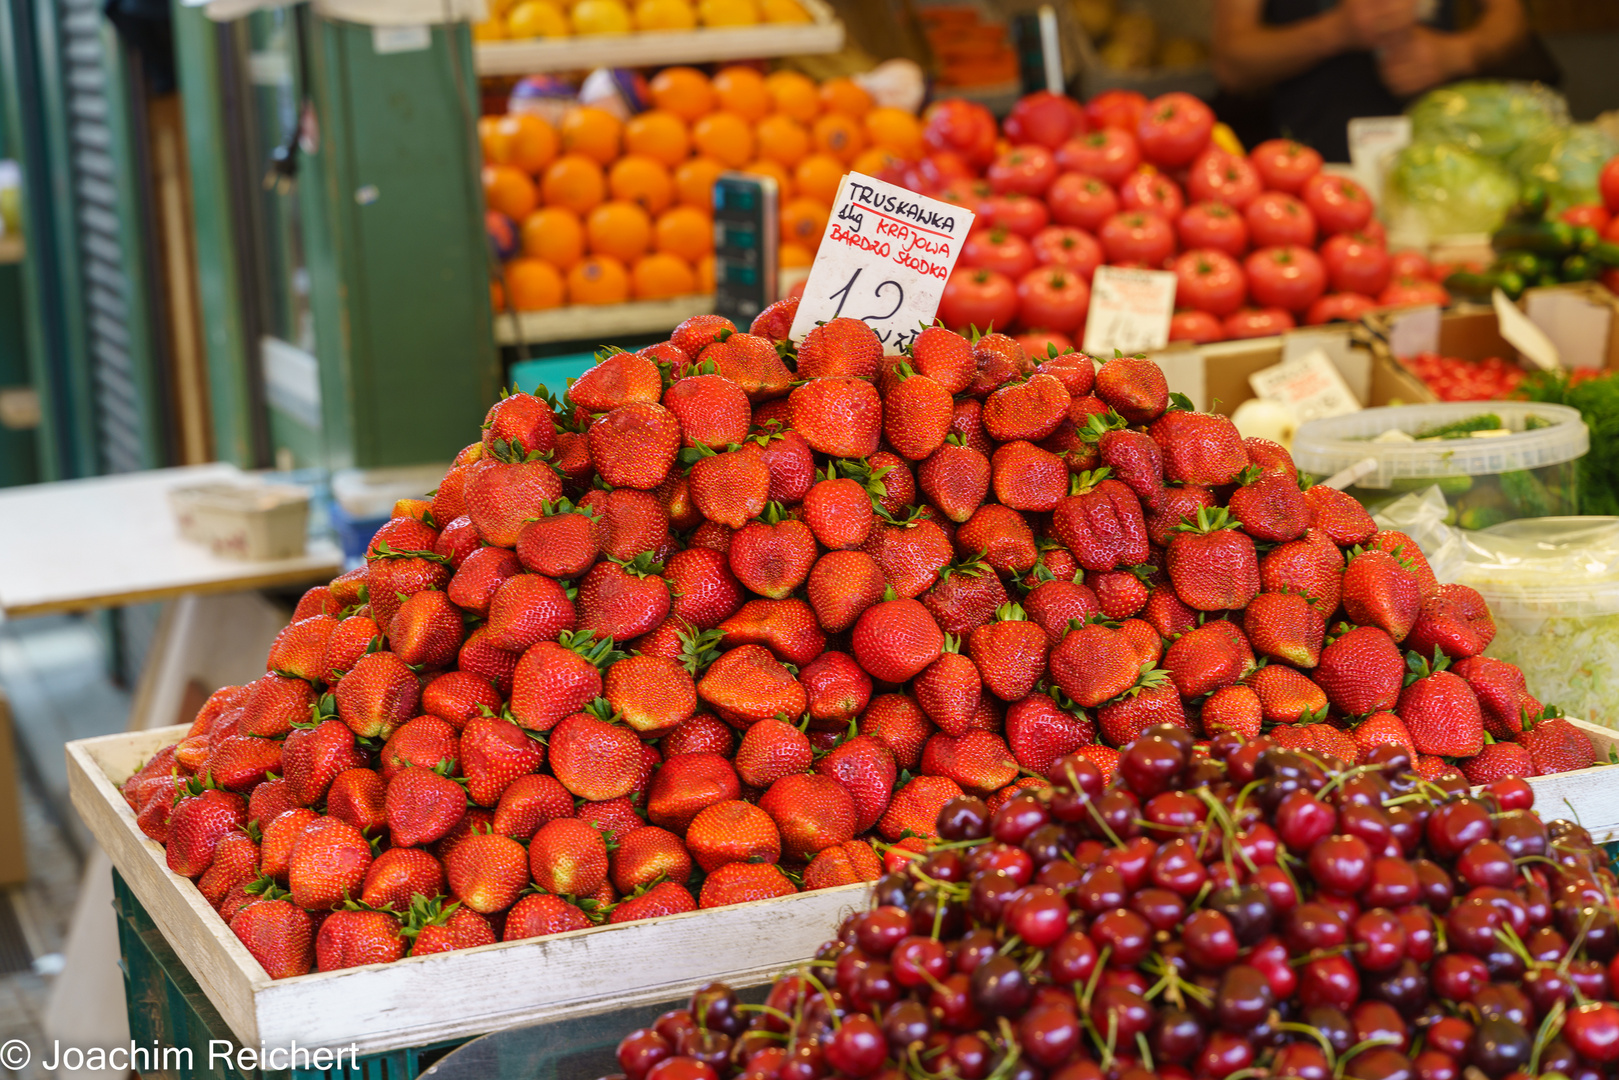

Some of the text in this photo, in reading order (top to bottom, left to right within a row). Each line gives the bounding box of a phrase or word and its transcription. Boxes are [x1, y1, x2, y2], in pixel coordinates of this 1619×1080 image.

[850, 182, 955, 233] TRUSKAWKA
[829, 223, 890, 258] BARDZO
[876, 218, 950, 258] KRAJOWA
[829, 267, 904, 321] 12
